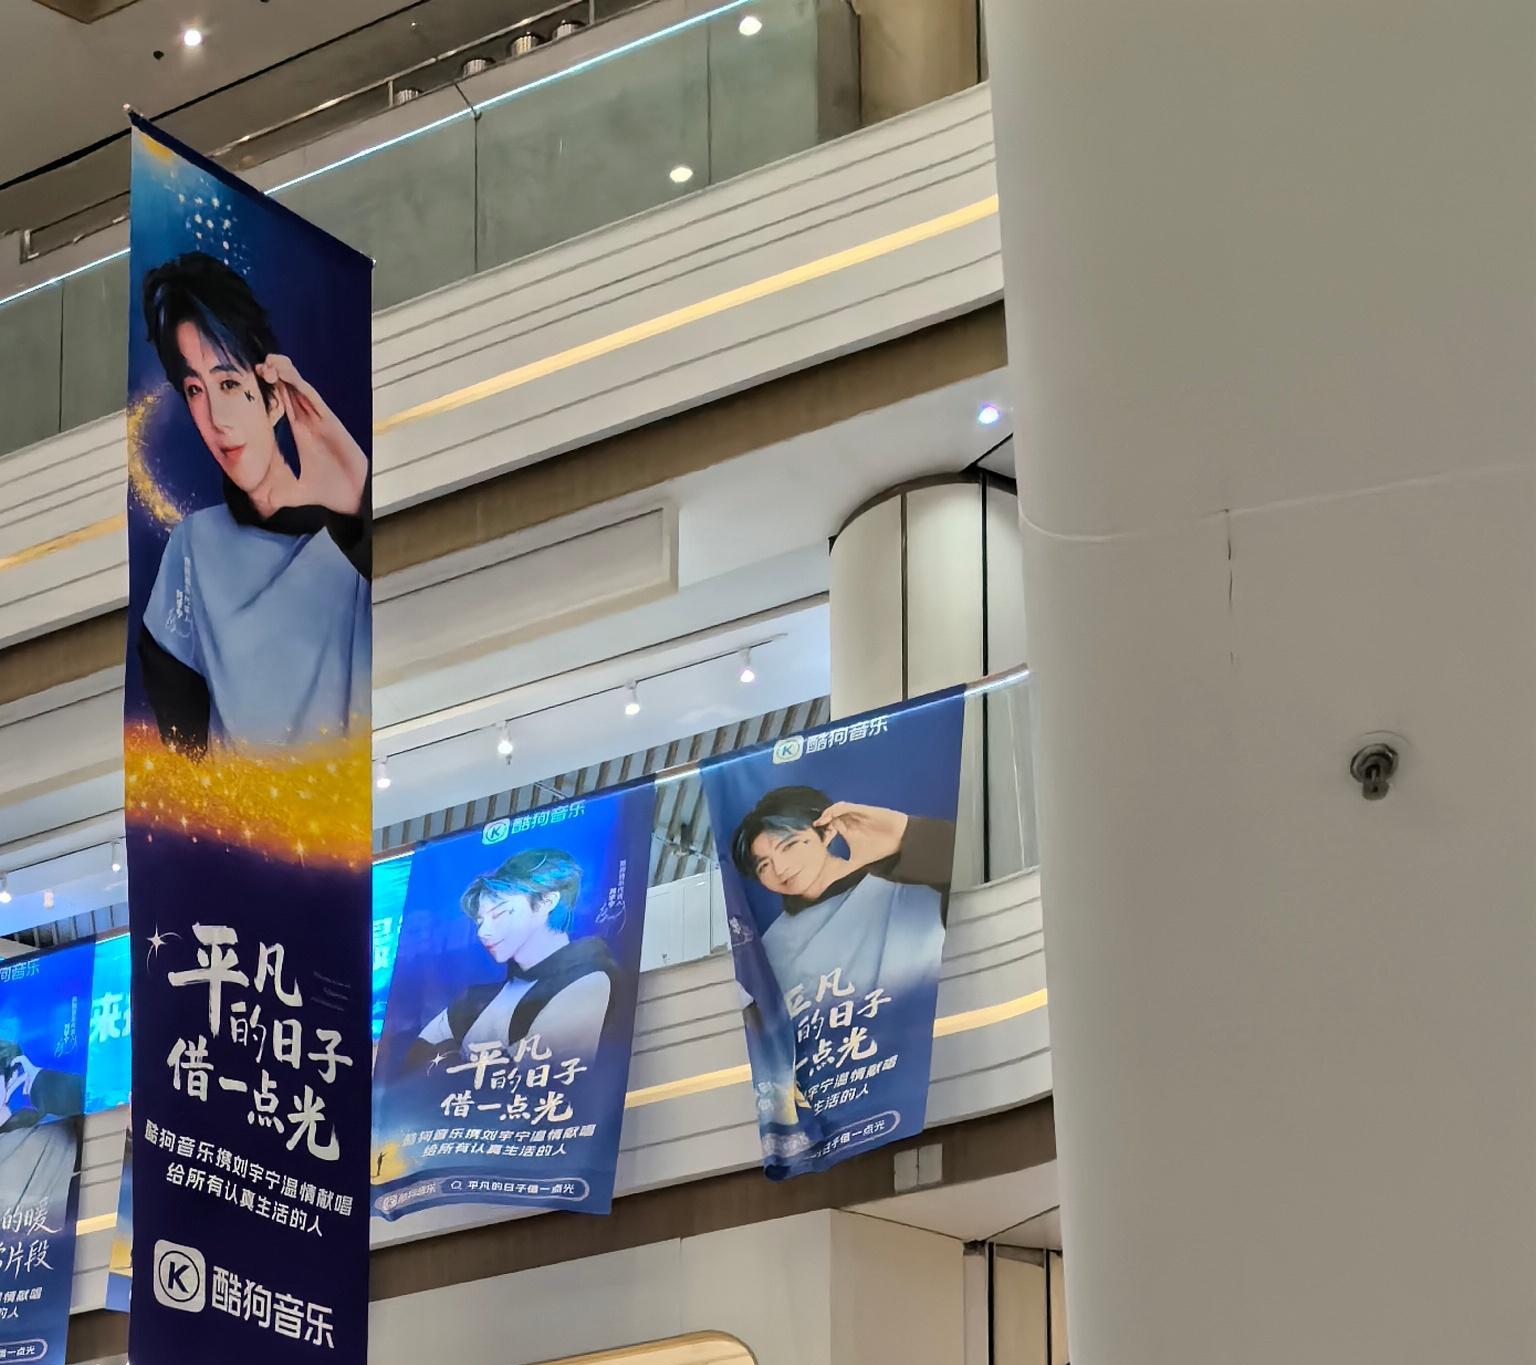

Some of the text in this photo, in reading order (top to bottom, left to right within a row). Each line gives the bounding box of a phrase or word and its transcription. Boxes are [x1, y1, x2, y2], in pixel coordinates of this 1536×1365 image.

[805, 717, 889, 754] 酷狗音乐
[512, 801, 586, 834] 酷狗音乐
[169, 922, 302, 1038] 平凡
[231, 1004, 353, 1084] 的日子
[446, 1033, 551, 1088] 平凡
[491, 1051, 587, 1093] 的日子
[168, 1037, 339, 1160] 借一点光
[441, 1092, 574, 1122] 借一点光
[404, 1123, 595, 1145] 酷狗音乐携刘宇宁温情献唱
[423, 1142, 567, 1158] 给所有认真生活的人
[145, 1119, 353, 1217] 酷狗音乐携刘宇宁温情献唱
[467, 1180, 575, 1196] 平凡的日子借一点光
[166, 1161, 323, 1236] 给所有认真生活的人
[212, 1265, 334, 1348] 酷狗音乐
